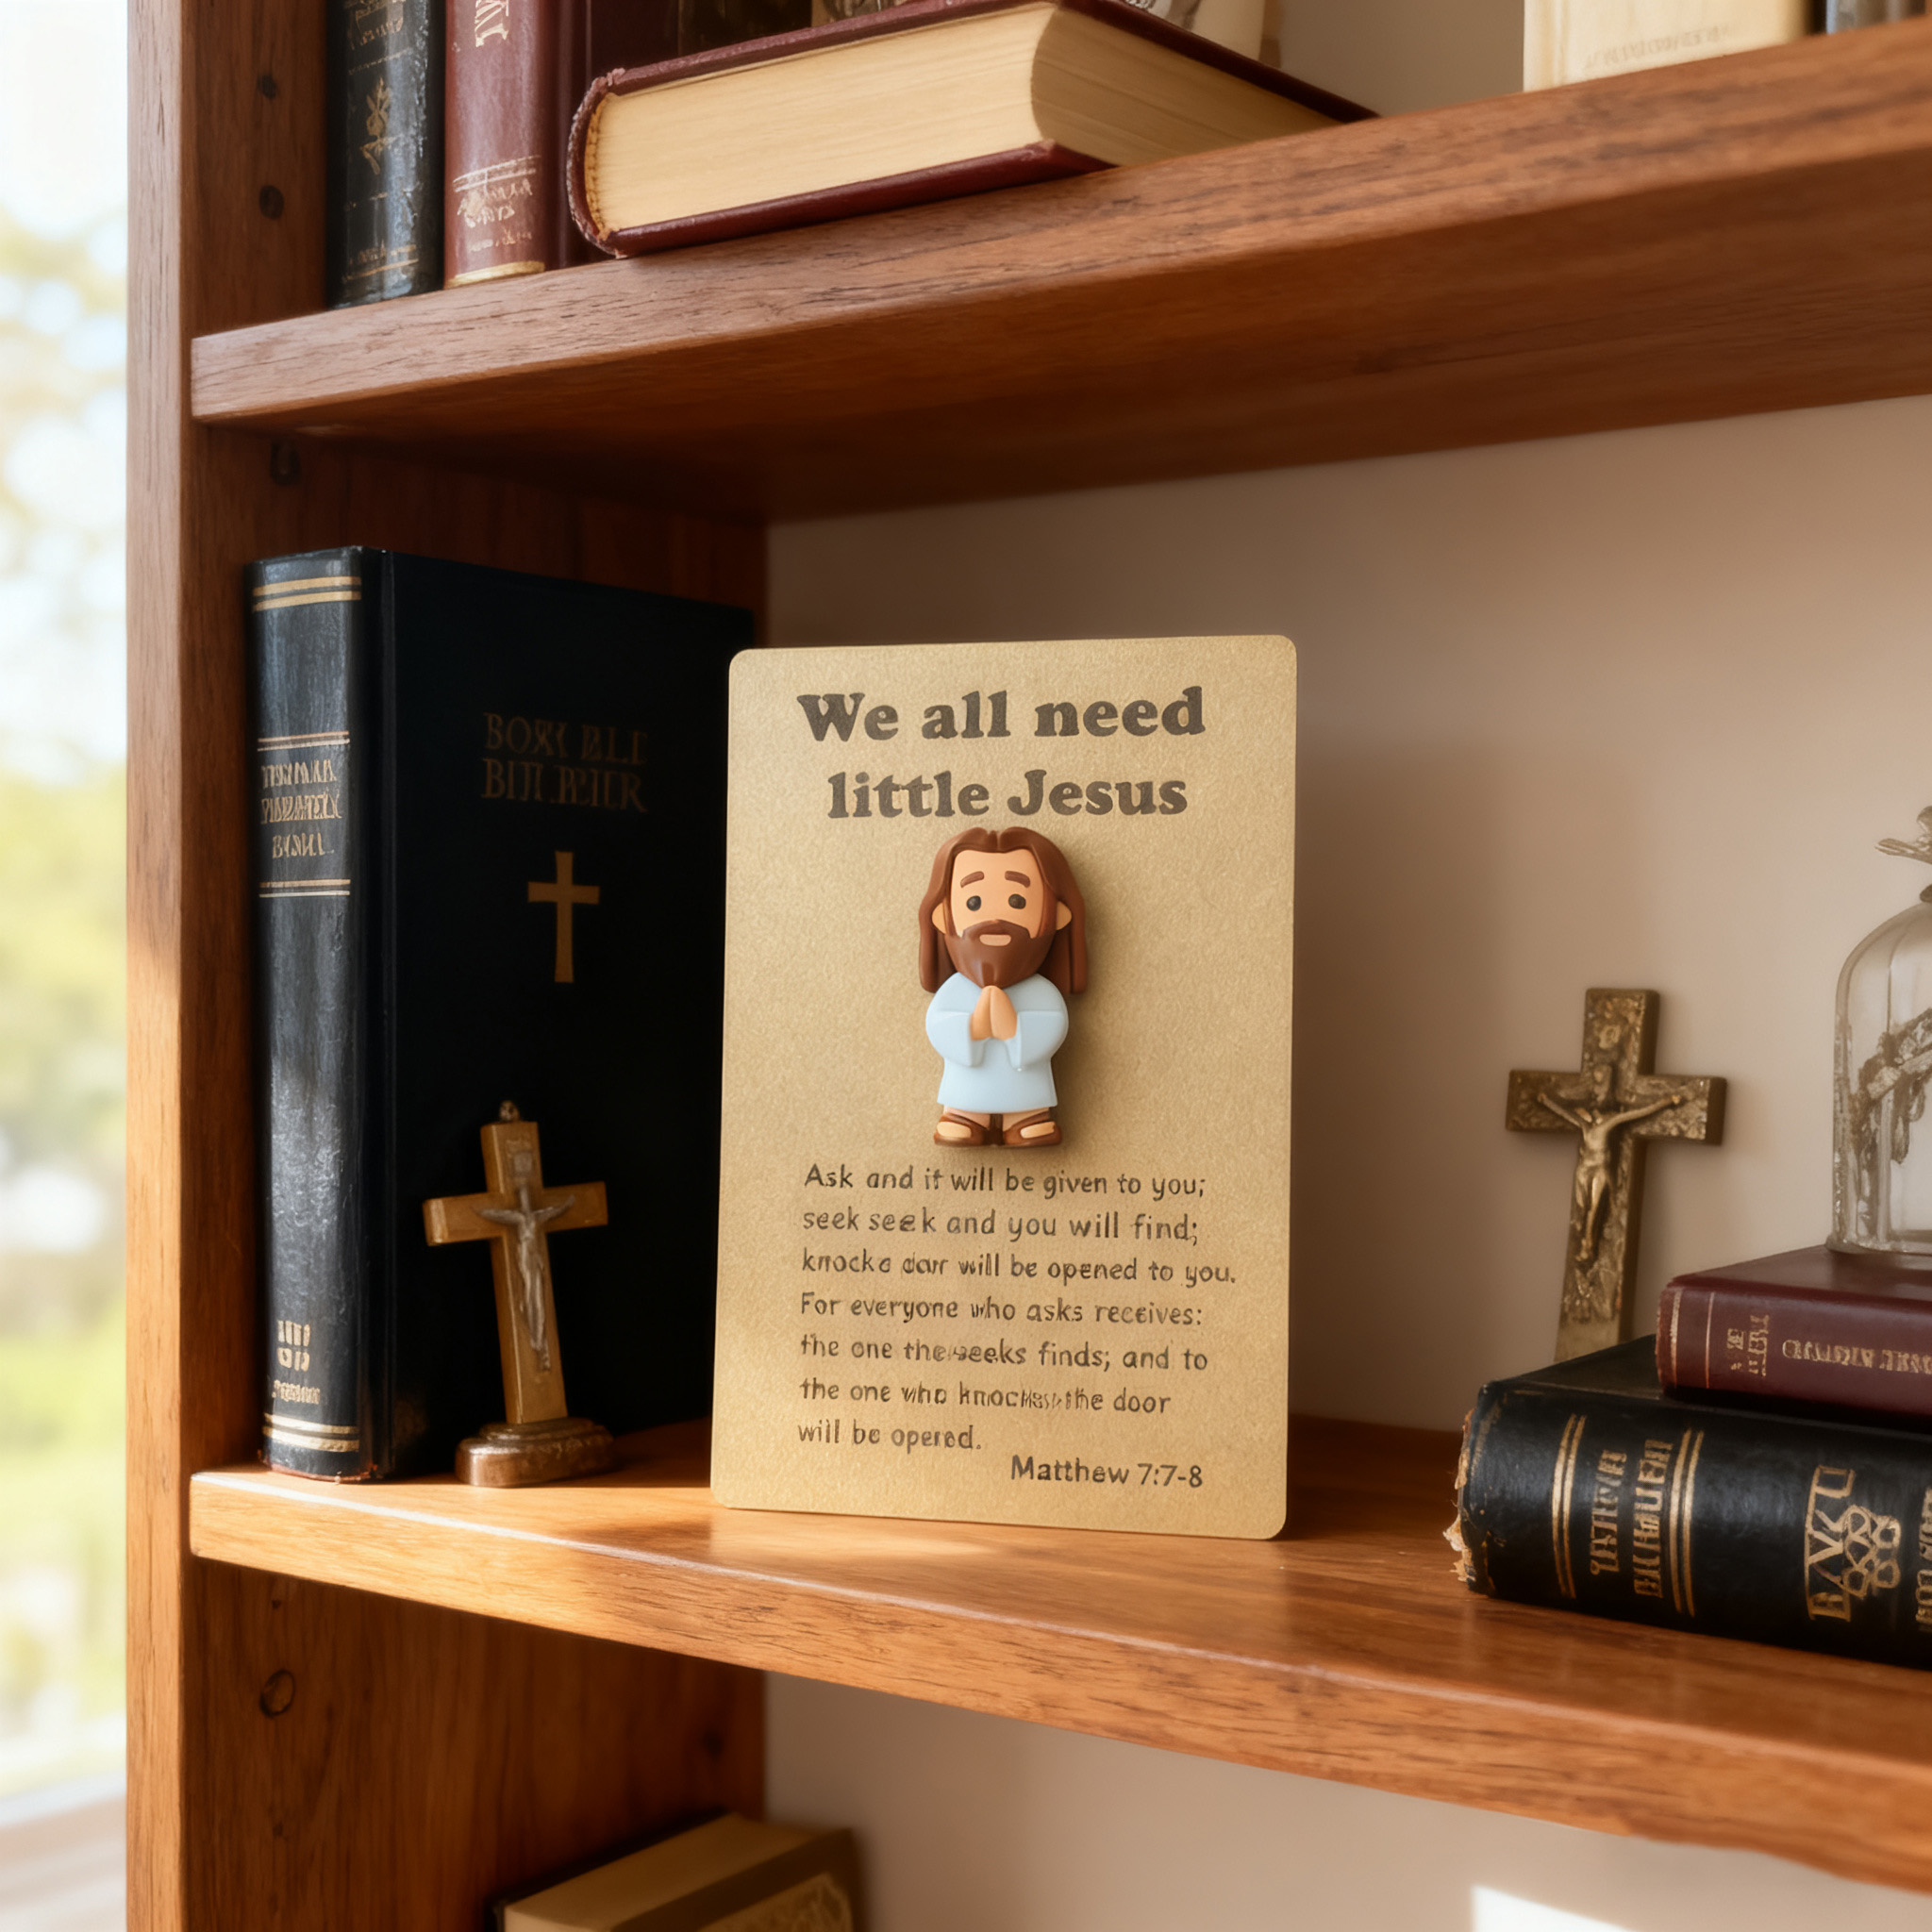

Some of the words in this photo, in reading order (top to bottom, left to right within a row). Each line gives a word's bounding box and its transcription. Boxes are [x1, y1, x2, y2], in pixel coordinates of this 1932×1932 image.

[797, 692, 898, 741] We
[922, 691, 1010, 739] all
[1034, 686, 1206, 737] need
[828, 771, 989, 819] little
[1008, 770, 1187, 815] Jesus
[805, 1163, 853, 1188] Ask
[867, 1165, 913, 1189] and
[924, 1168, 943, 1190] it
[951, 1166, 992, 1191] will
[1006, 1168, 1034, 1191] be
[1043, 1170, 1107, 1199] given
[1117, 1174, 1141, 1194] to
[1153, 1178, 1206, 1202] you;
[804, 1206, 858, 1231] seek
[869, 1207, 936, 1233] seek
[947, 1208, 995, 1234] and
[1008, 1218, 1056, 1242] you
[1070, 1211, 1118, 1238] will
[1134, 1213, 1197, 1246] find;
[958, 1253, 999, 1276] will
[1011, 1254, 1037, 1277] be
[1048, 1257, 1137, 1286] opened
[1148, 1261, 1173, 1281] to
[1186, 1266, 1236, 1289] you.
[802, 1291, 841, 1315] For
[851, 1299, 958, 1324] everyone
[971, 1295, 1015, 1321] who
[1026, 1297, 1082, 1322] asks
[1095, 1302, 1202, 1325] receives:
[801, 1333, 839, 1357] the
[851, 1341, 891, 1358] one
[1039, 1341, 1109, 1372] finds;
[1123, 1346, 1169, 1369] and
[1184, 1349, 1208, 1370] to
[850, 1386, 891, 1402] one
[901, 1382, 946, 1404] who
[1113, 1387, 1171, 1413] door
[798, 1419, 840, 1443] will
[1011, 1455, 1129, 1484] Matthew
[1138, 1463, 1203, 1488] 7:7-8
